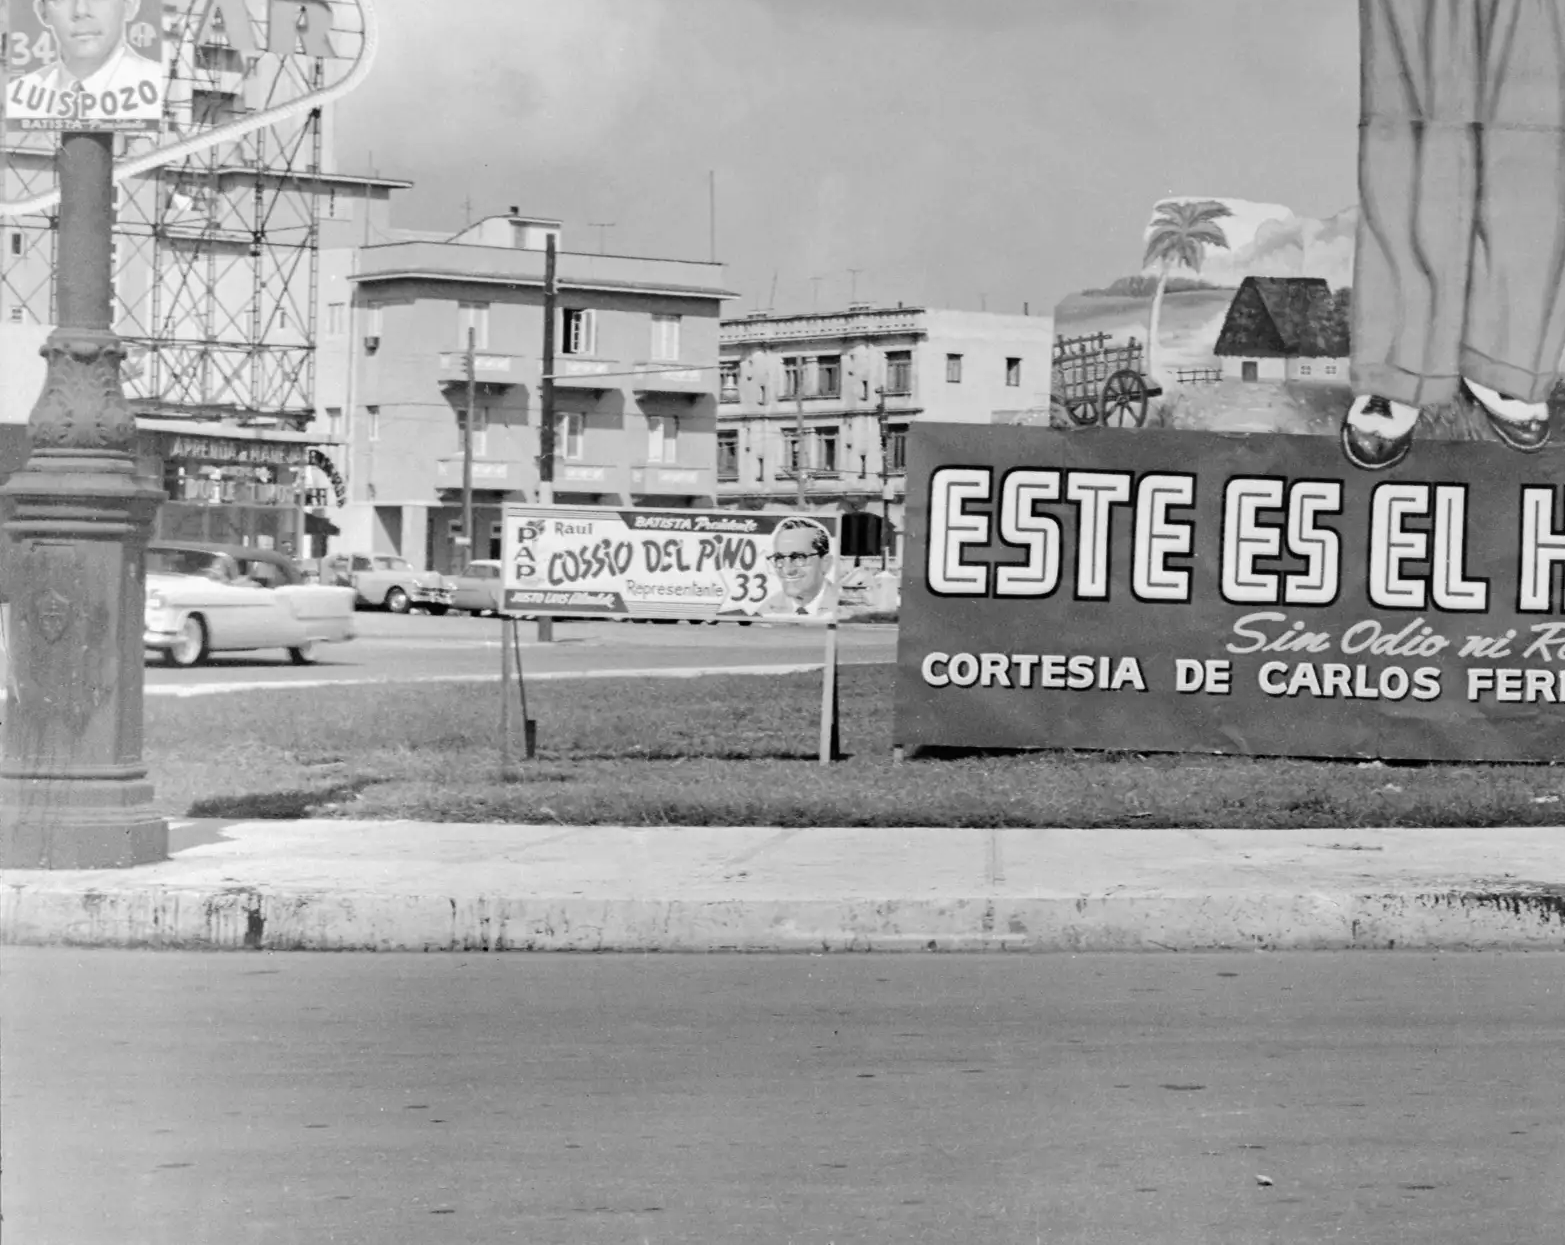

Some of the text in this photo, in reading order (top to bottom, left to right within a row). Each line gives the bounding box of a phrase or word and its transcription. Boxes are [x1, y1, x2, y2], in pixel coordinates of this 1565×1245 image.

[11, 30, 55, 66] 34
[11, 80, 157, 117] LUIS POZO
[554, 521, 593, 536] Raul
[634, 516, 692, 531] BATISTA
[925, 465, 1197, 602] ESTE
[1220, 475, 1343, 608] ES
[1368, 481, 1490, 614] EL
[642, 537, 691, 573] DEL
[625, 580, 723, 599] Representante
[731, 573, 768, 603] 33
[1227, 611, 1330, 659] Sin
[1341, 619, 1450, 661] Odio
[1457, 627, 1517, 660] ni
[921, 650, 1147, 693] CORTESIA
[1176, 657, 1231, 697] DE
[1258, 661, 1442, 703] CARLOS
